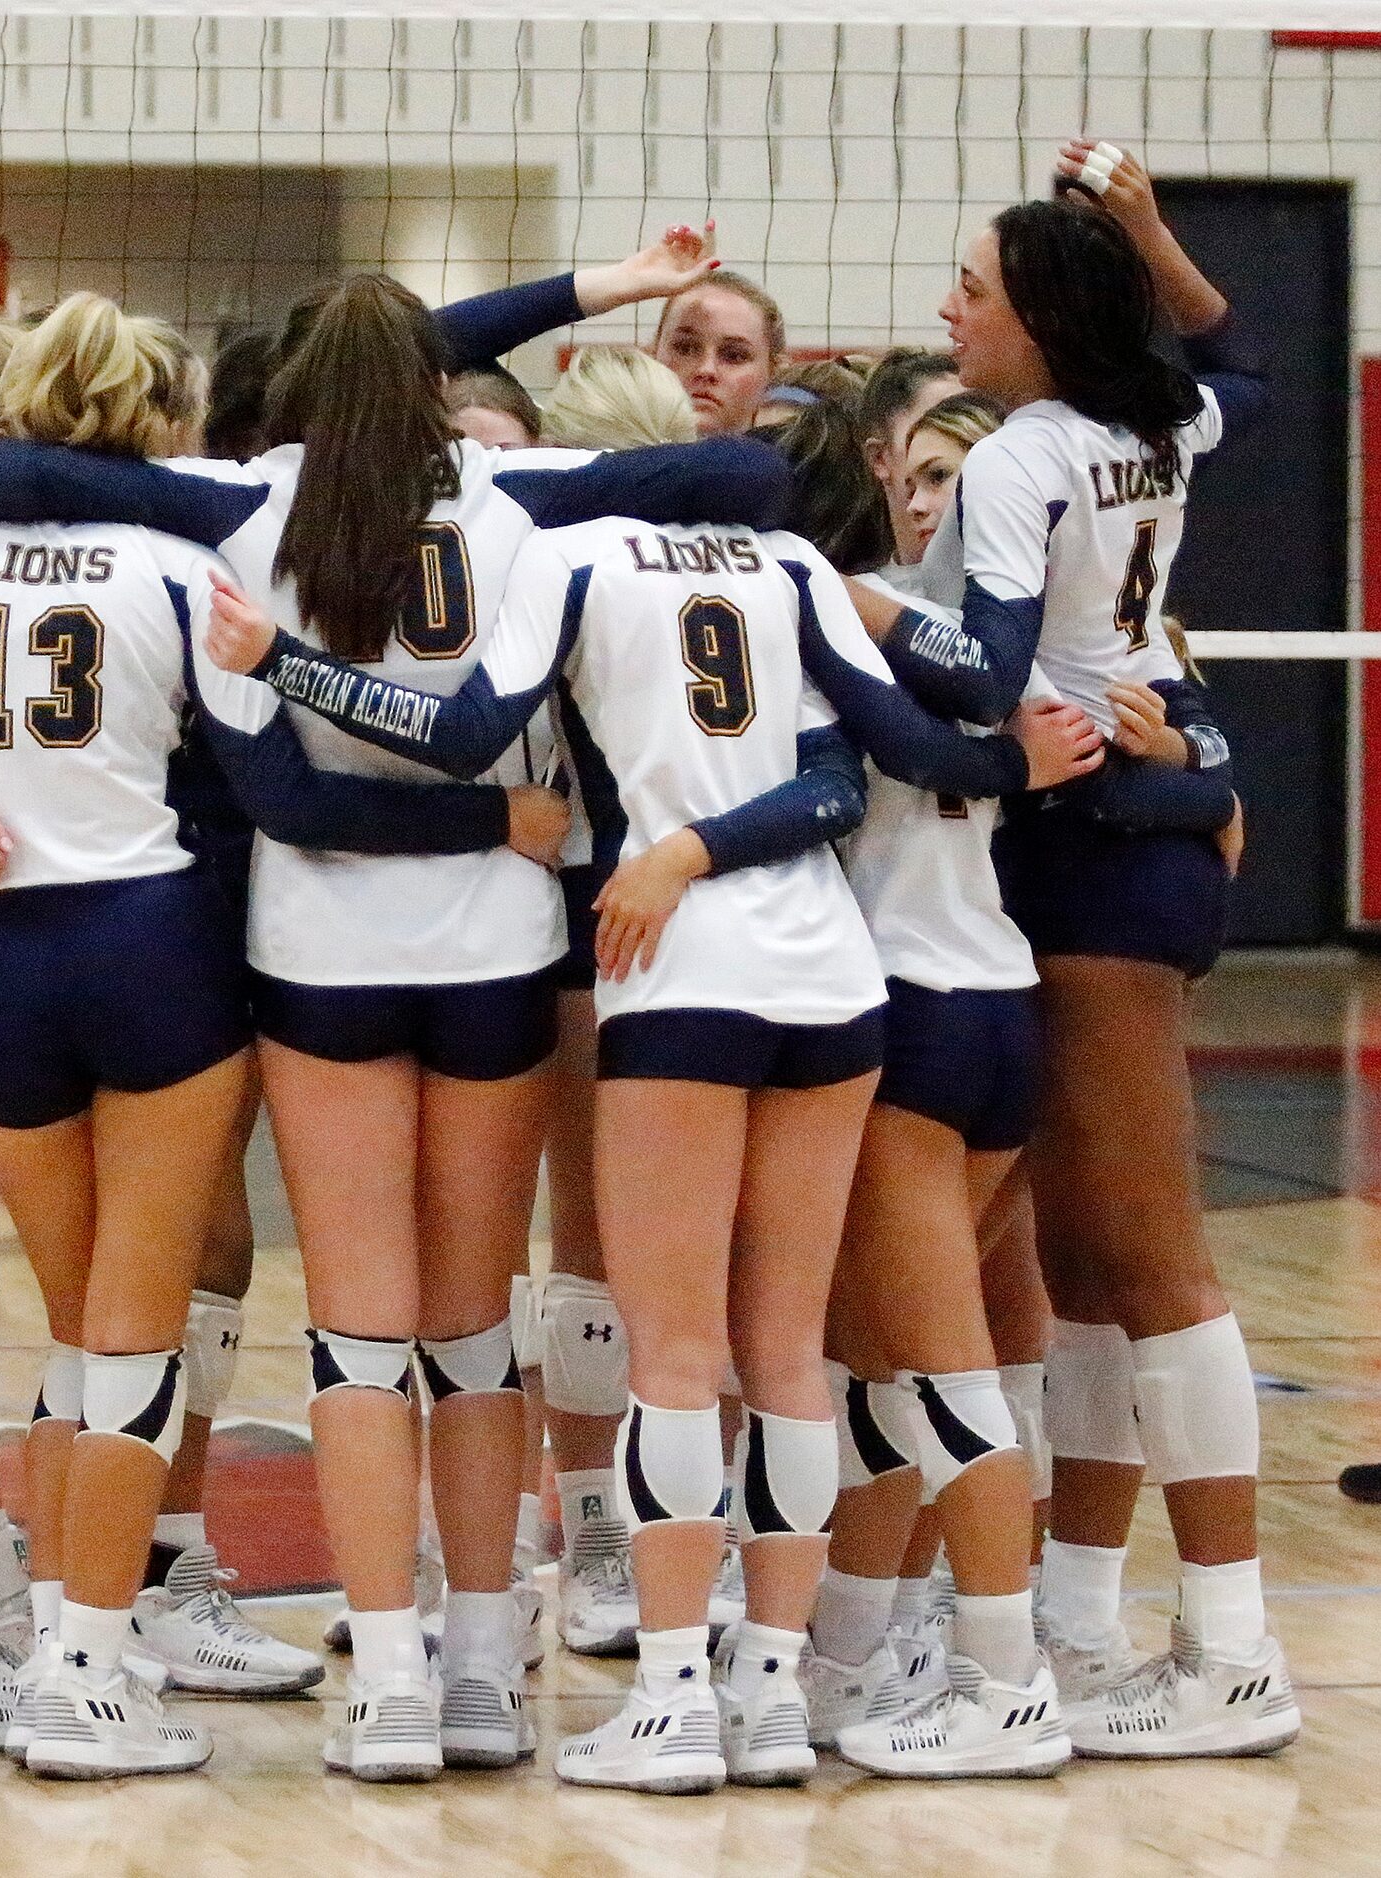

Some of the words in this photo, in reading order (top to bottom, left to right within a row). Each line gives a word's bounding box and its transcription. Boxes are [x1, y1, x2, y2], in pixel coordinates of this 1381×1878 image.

[1088, 459, 1174, 511] LION
[623, 533, 764, 575] LIONS
[1113, 518, 1158, 654] 4
[678, 593, 757, 737] 9
[352, 679, 440, 744] ACADEMY
[891, 1732, 947, 1753] ADVISORY
[1107, 1715, 1166, 1735] ADVISORY
